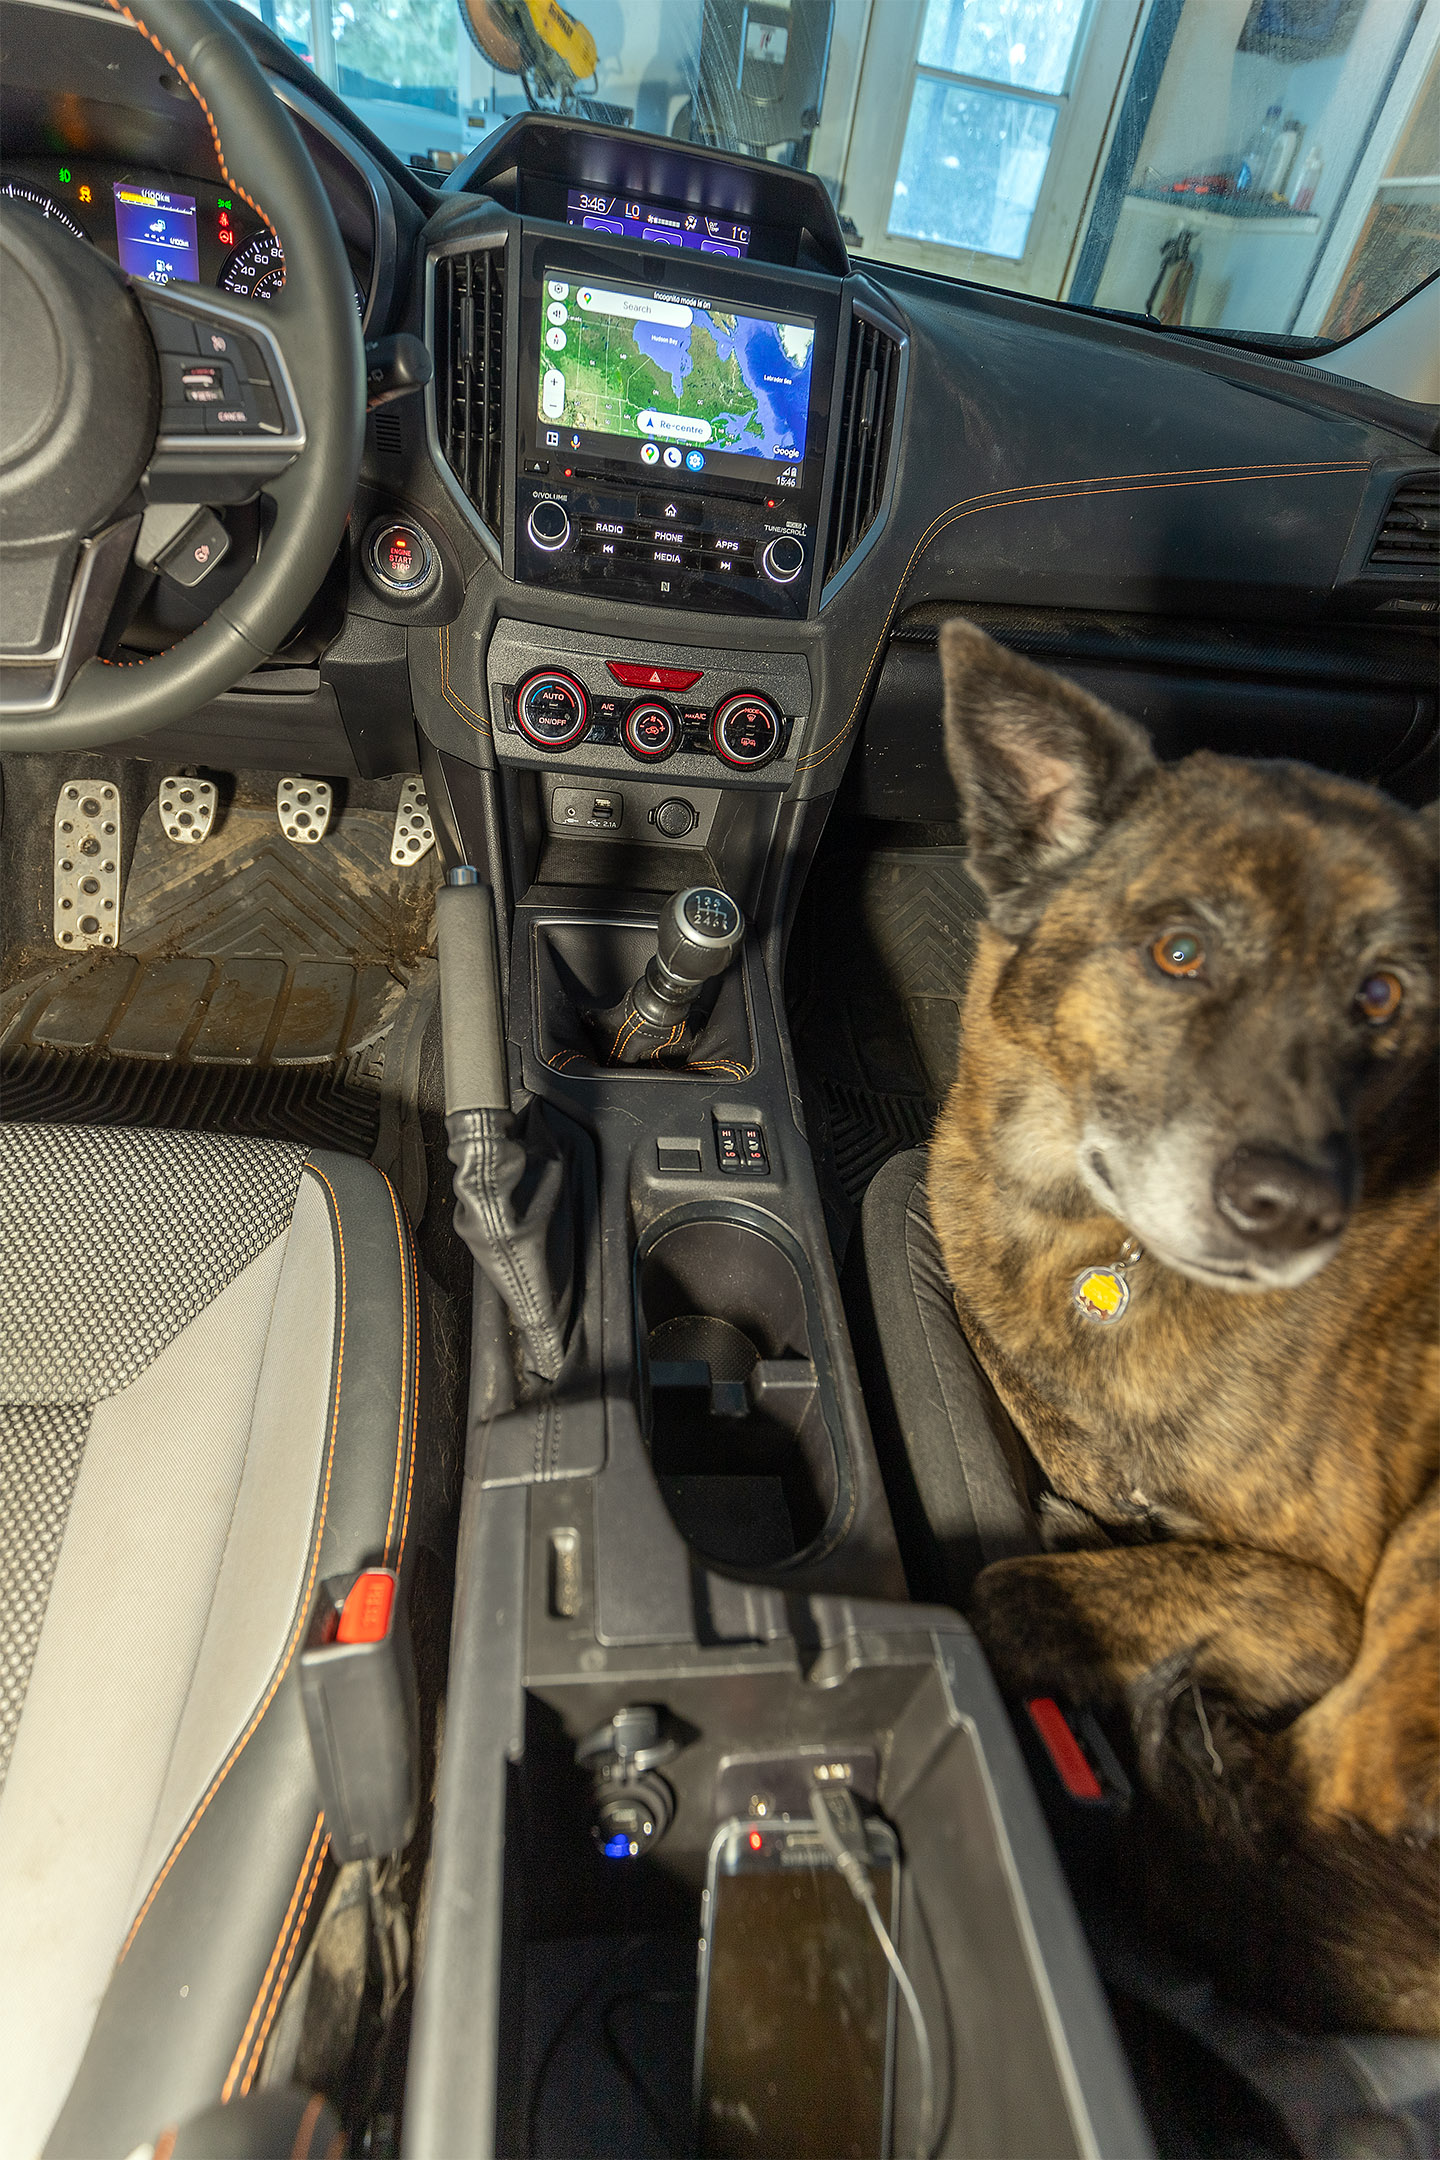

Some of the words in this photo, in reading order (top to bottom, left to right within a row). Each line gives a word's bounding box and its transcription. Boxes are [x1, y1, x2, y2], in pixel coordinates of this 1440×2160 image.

[579, 194, 607, 212] 3:46
[625, 203, 641, 217] LO
[254, 254, 269, 265] 60
[240, 266, 255, 276] 40
[148, 271, 169, 283] 470
[233, 284, 248, 295] 20
[261, 291, 271, 299] 20
[653, 291, 680, 303] Incognito
[680, 297, 697, 307] mode
[697, 299, 703, 308] is
[703, 301, 711, 310] on
[623, 301, 652, 314] Search
[669, 337, 678, 346] Bay
[660, 420, 704, 435] Re-centre
[773, 444, 800, 459] Google
[596, 523, 624, 534] RADIO
[764, 524, 807, 537] TUNE/SCROLL
[654, 531, 684, 543] PHONE
[715, 540, 739, 551] APPS
[390, 547, 411, 557] ENGINE
[653, 551, 682, 563] MEDIA
[389, 554, 412, 565] START
[391, 562, 410, 571] STOP
[543, 692, 565, 701] AUTO
[601, 703, 615, 711] A/C
[538, 717, 567, 726] ON/OFF
[603, 820, 617, 828] 2.1A
[694, 914, 702, 924] 2
[703, 916, 711, 926] 4
